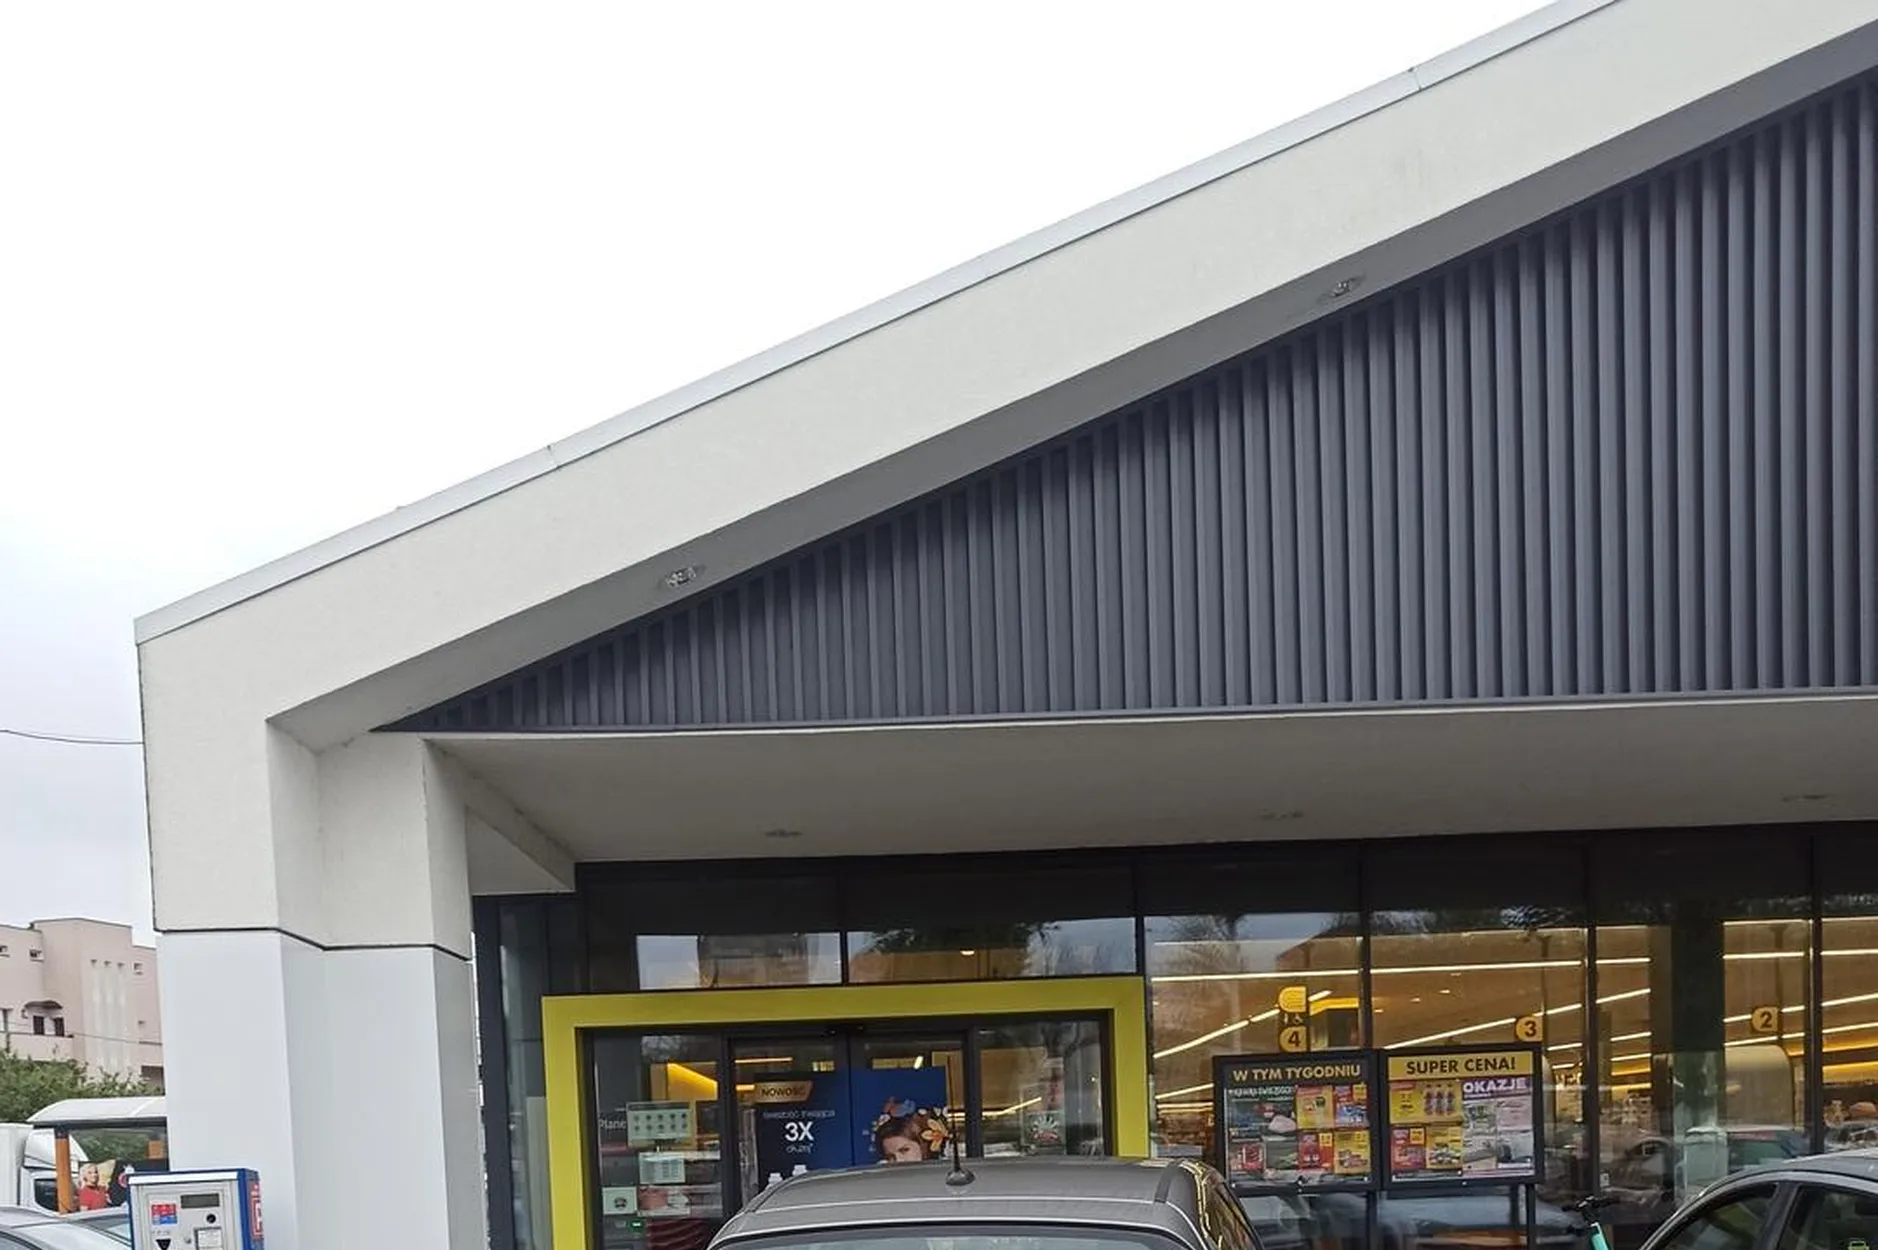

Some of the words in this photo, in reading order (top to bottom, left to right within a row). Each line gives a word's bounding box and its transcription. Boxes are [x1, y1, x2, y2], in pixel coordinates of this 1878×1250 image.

[1524, 1020, 1536, 1037] 3
[1760, 1011, 1773, 1028] 2
[1287, 1030, 1301, 1048] 4
[1233, 1070, 1248, 1082] W
[1252, 1068, 1282, 1080] TYM
[1285, 1064, 1361, 1079] TYGODNIU
[1406, 1059, 1459, 1075] SUPER
[1463, 1056, 1517, 1072] CENA!
[784, 1121, 815, 1142] 3X
